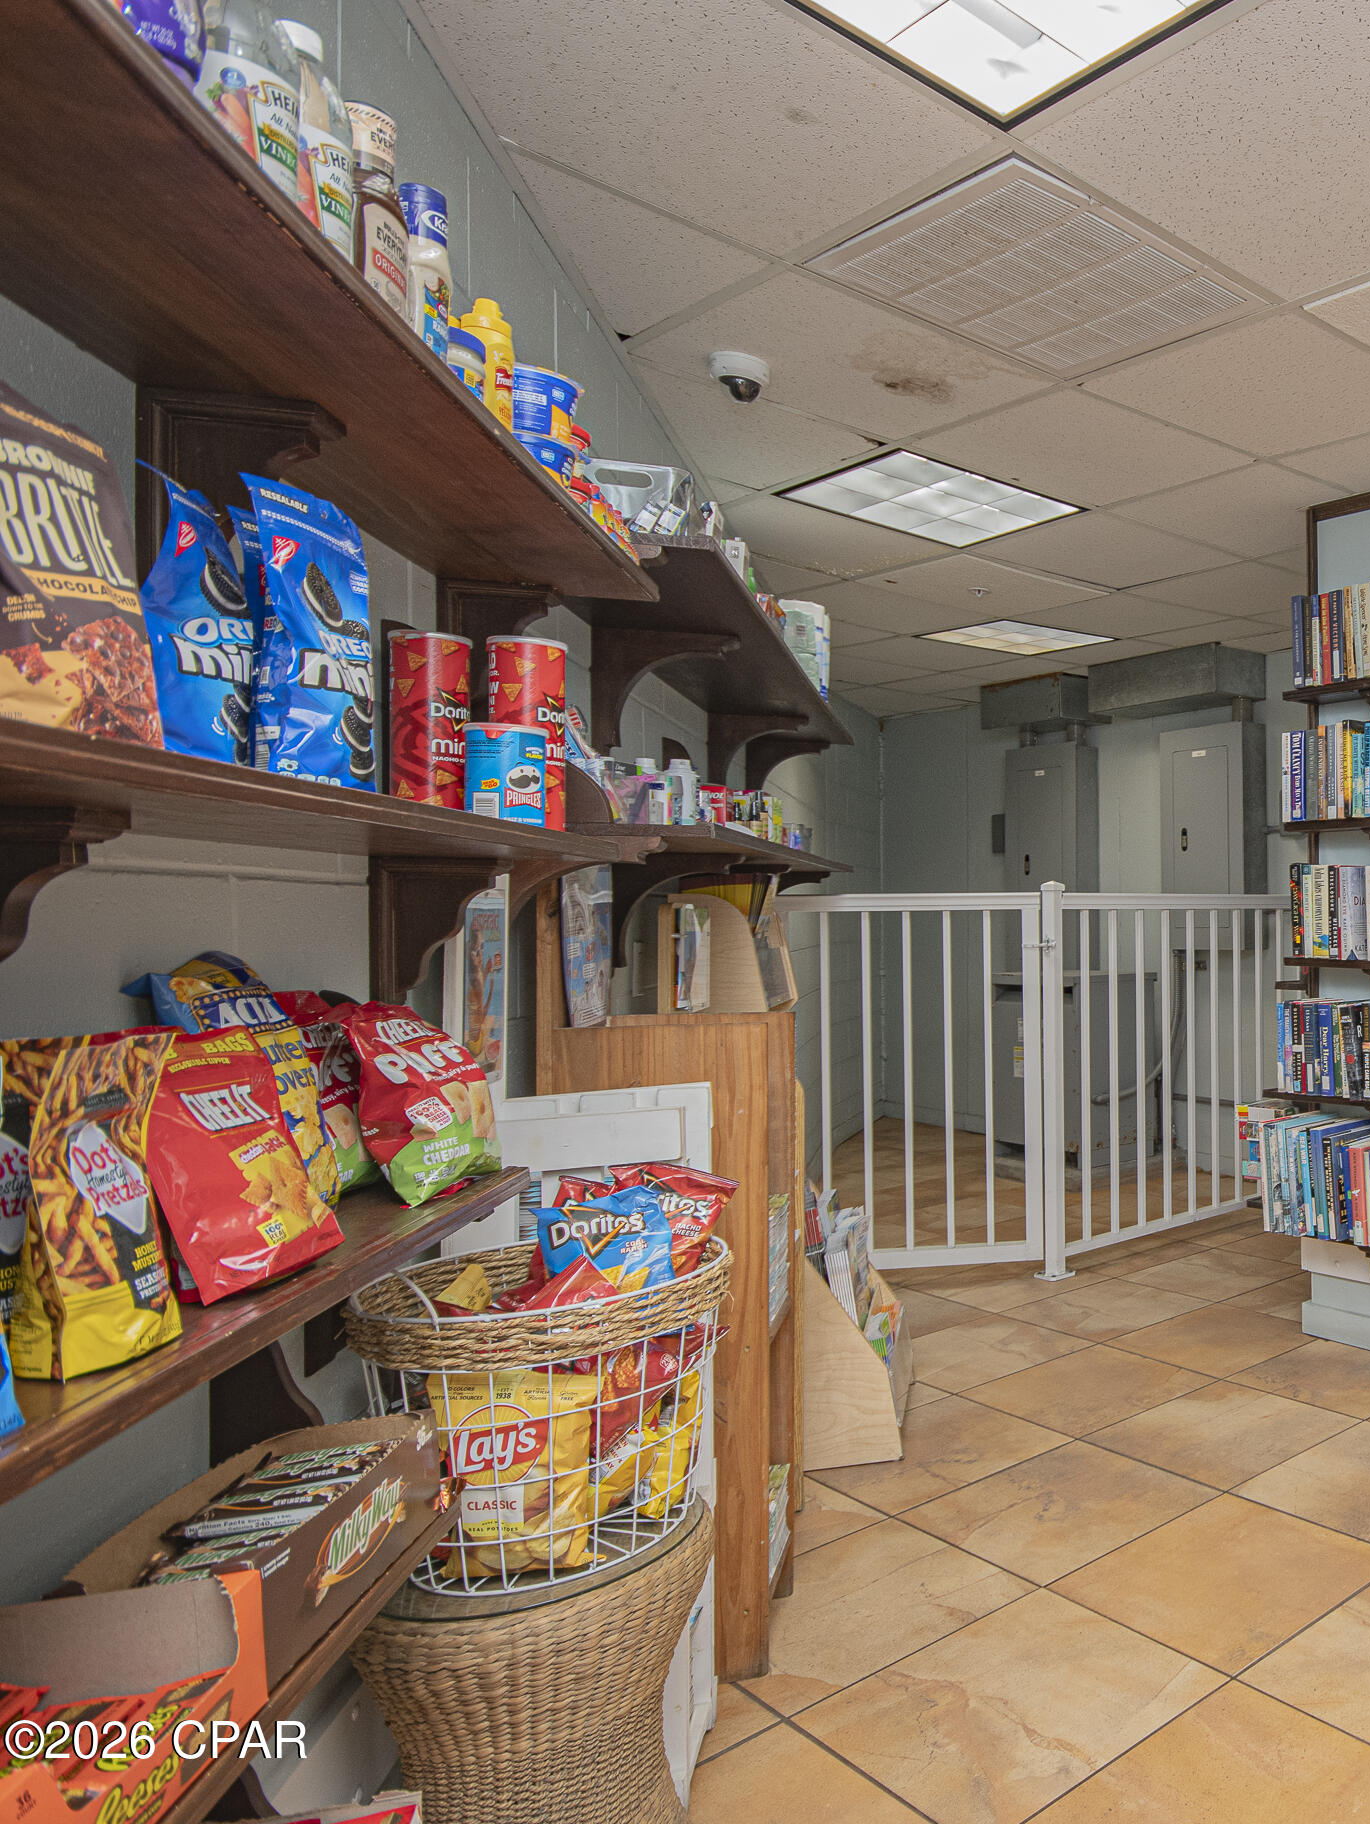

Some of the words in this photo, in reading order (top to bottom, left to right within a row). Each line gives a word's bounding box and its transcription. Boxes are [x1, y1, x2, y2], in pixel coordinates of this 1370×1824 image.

[260, 487, 308, 513] RESEALABLE
[1292, 733, 1301, 748] TOM
[1292, 749, 1301, 775] CLANCY
[506, 789, 541, 808] PRINGLES
[201, 1032, 255, 1054] BAGS
[1321, 1026, 1329, 1047] Dear
[261, 1040, 308, 1065] utter
[275, 1067, 317, 1096] overs
[422, 1143, 470, 1165] CHEDDAR
[423, 1136, 458, 1152] WHITE
[85, 1177, 148, 1212] Pretzels
[660, 1193, 712, 1217] itos
[550, 1213, 646, 1249] Doritos
[671, 1229, 701, 1238] CHEESE
[674, 1223, 702, 1232] NACHO
[495, 1392, 512, 1400] 1938
[456, 1422, 538, 1475] Lay's
[466, 1500, 517, 1512] CLASSIC
[224, 1519, 245, 1527] Facts
[327, 1500, 372, 1574] Milky
[368, 1476, 404, 1538] Way
